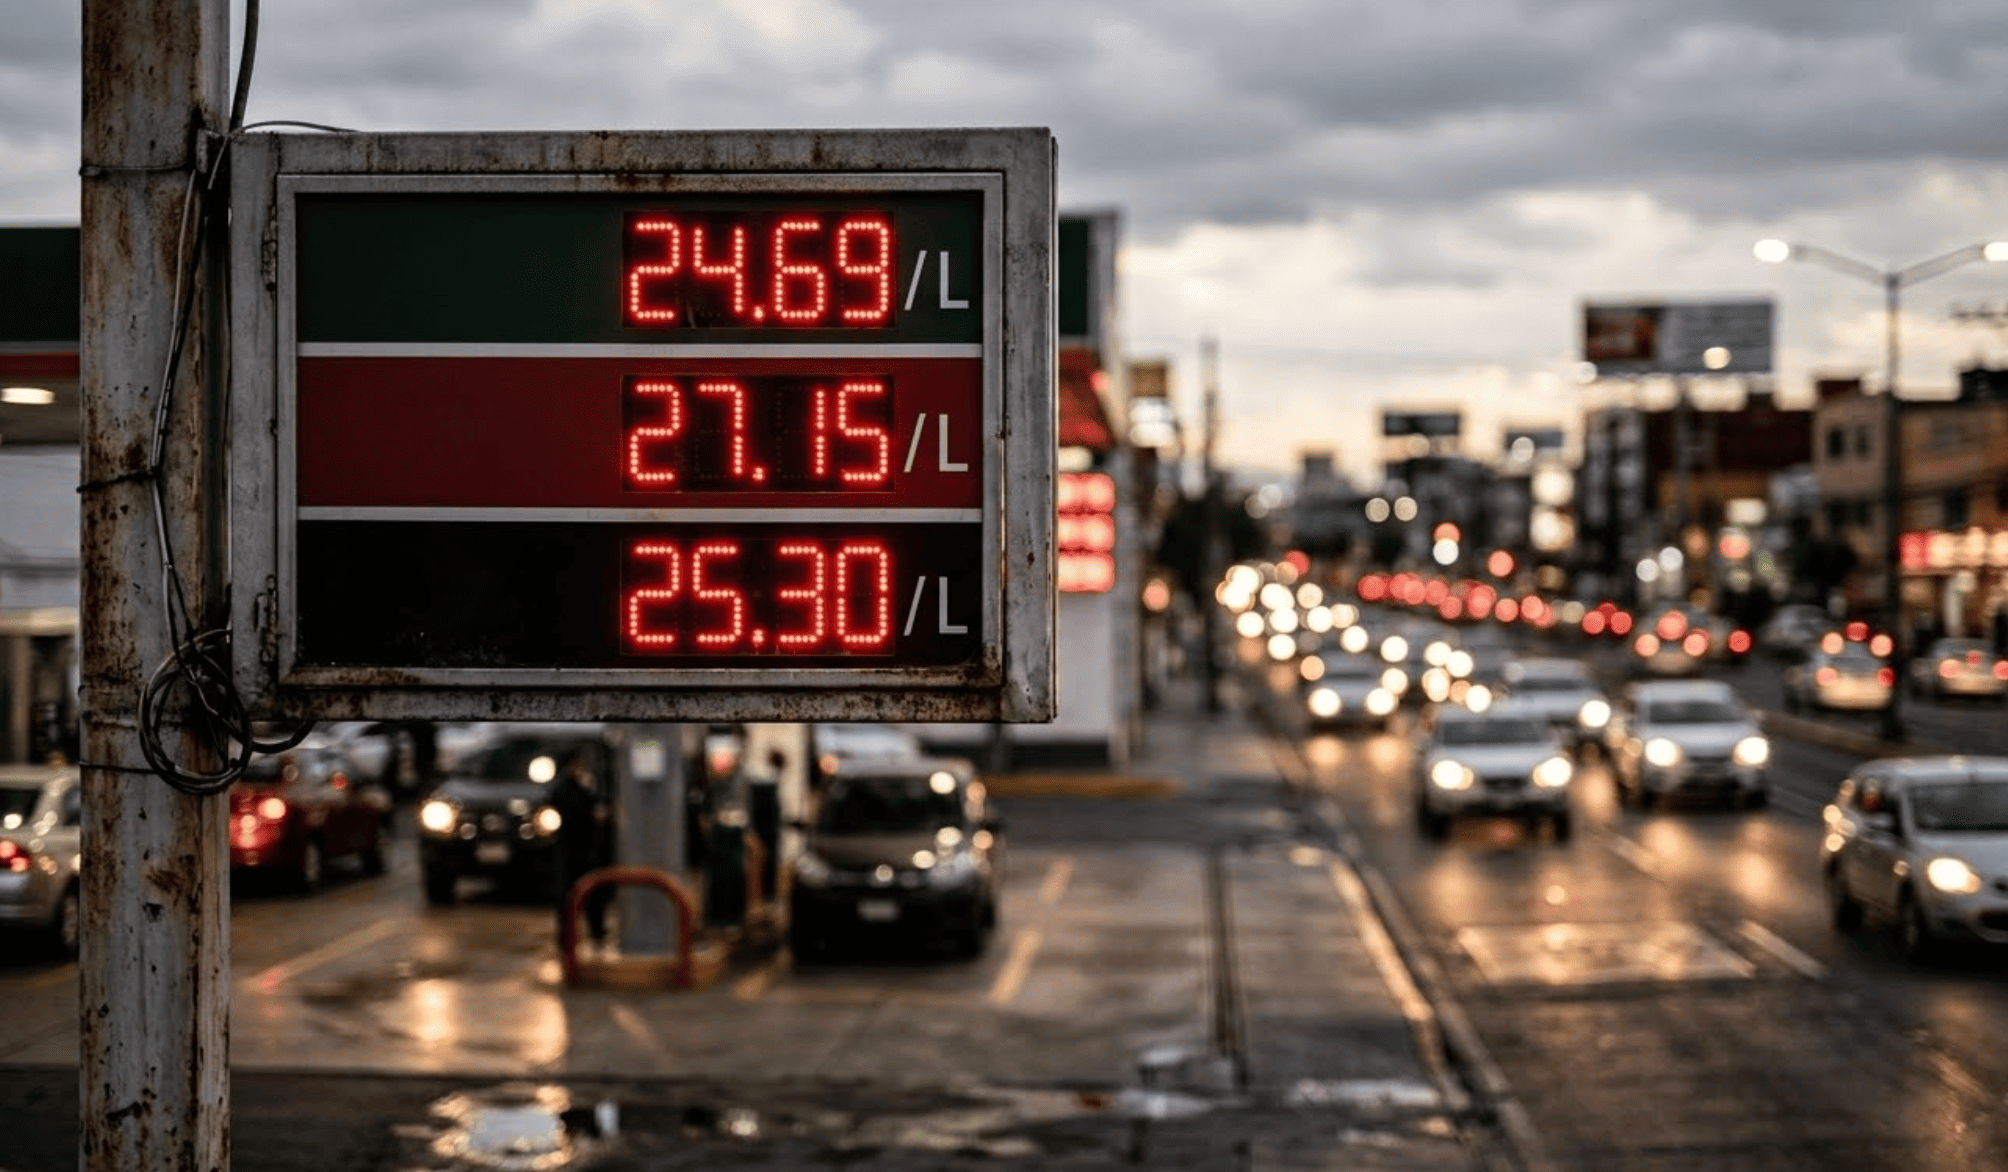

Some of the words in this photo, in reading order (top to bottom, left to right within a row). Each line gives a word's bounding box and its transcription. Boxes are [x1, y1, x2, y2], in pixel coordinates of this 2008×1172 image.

[629, 220, 890, 321] 24.69
[904, 250, 969, 311] /L
[628, 382, 889, 484] 27.15
[904, 413, 969, 473] /L
[628, 543, 889, 647] 25.30
[904, 575, 968, 636] /L
